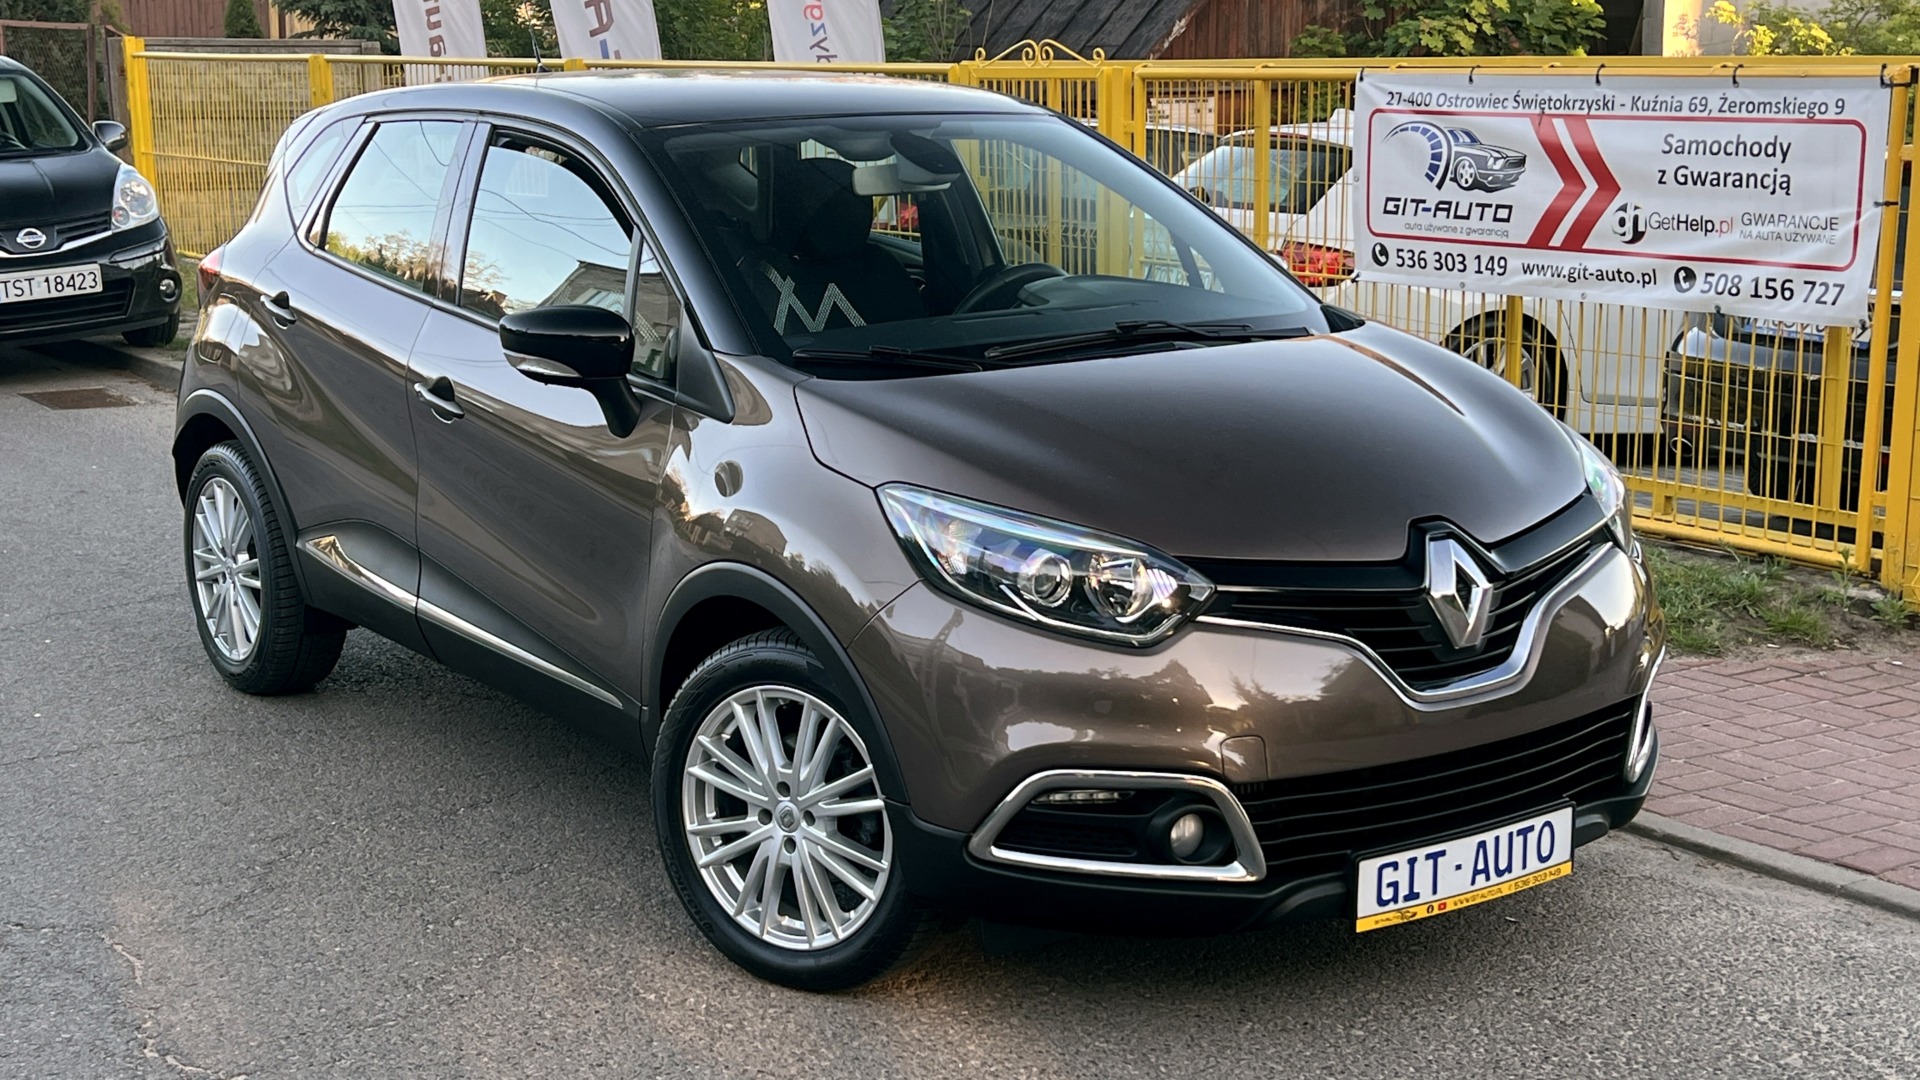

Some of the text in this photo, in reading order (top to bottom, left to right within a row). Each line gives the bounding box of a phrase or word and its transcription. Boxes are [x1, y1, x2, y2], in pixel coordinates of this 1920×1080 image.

[1386, 91, 1432, 108] 27-400
[1436, 91, 1509, 109] Ostrowiec
[1512, 89, 1616, 115] Świętokrzyski
[1630, 94, 1683, 113] Kuźnia
[1688, 96, 1713, 116] 69,
[1718, 92, 1829, 119] Żeromskiego
[1834, 98, 1846, 115] 9
[1661, 133, 1792, 164] Samochody
[1657, 165, 1791, 196] z Gwarancją
[1382, 196, 1513, 223] GIT-AUTO
[1741, 211, 1839, 231] GWARANCJE
[1404, 221, 1422, 231] auta
[1424, 222, 1458, 234] używane
[1465, 227, 1510, 239] gwarancją
[1648, 211, 1734, 239] GetHelp.pl
[1739, 229, 1753, 240] NA
[1754, 231, 1782, 241] AUTA
[1396, 248, 1508, 276] 536 303 149
[1521, 262, 1657, 288] www.git-auto.pl
[0, 271, 98, 299] TST 18423
[1700, 272, 1845, 306] 508 156 727
